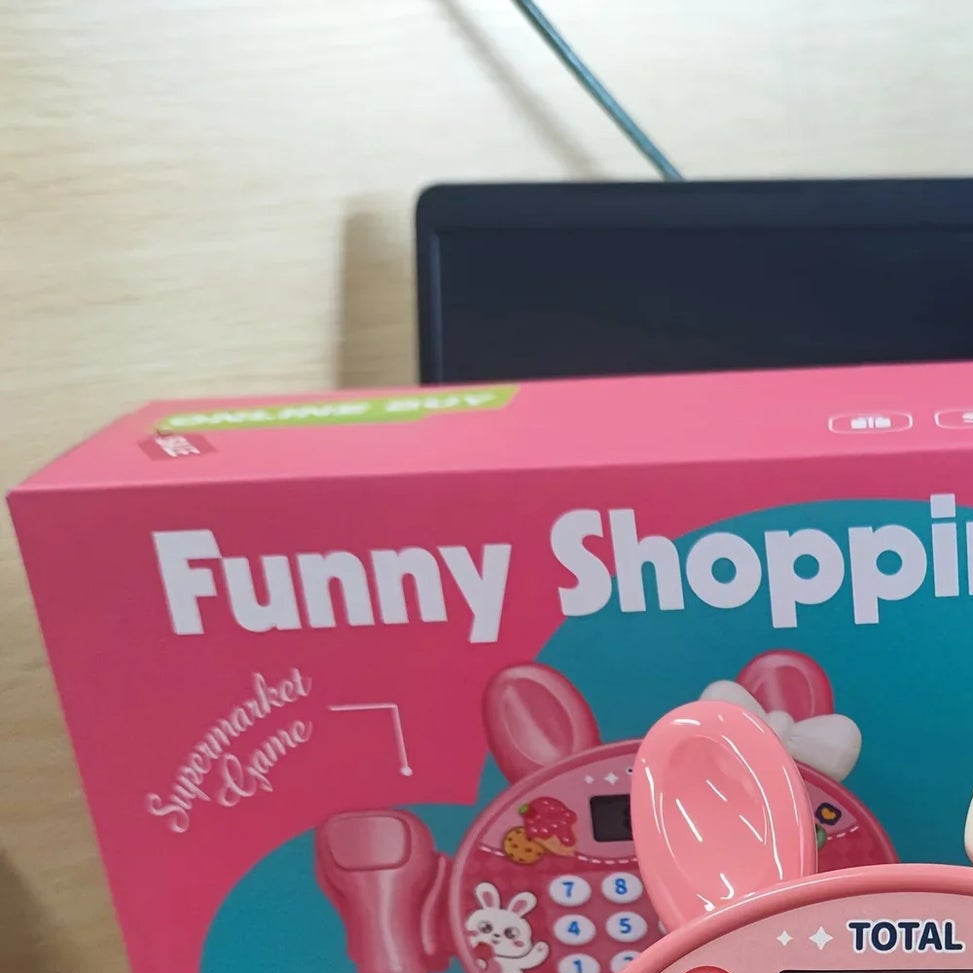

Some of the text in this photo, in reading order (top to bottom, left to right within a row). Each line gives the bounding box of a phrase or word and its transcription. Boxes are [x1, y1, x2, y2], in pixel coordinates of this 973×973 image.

[151, 529, 512, 643] Funny
[146, 668, 312, 833] Supermarket
[217, 720, 312, 807] Game
[562, 878, 628, 898] 7 8
[567, 917, 632, 936] 4 5
[848, 920, 964, 952] TOTAL
